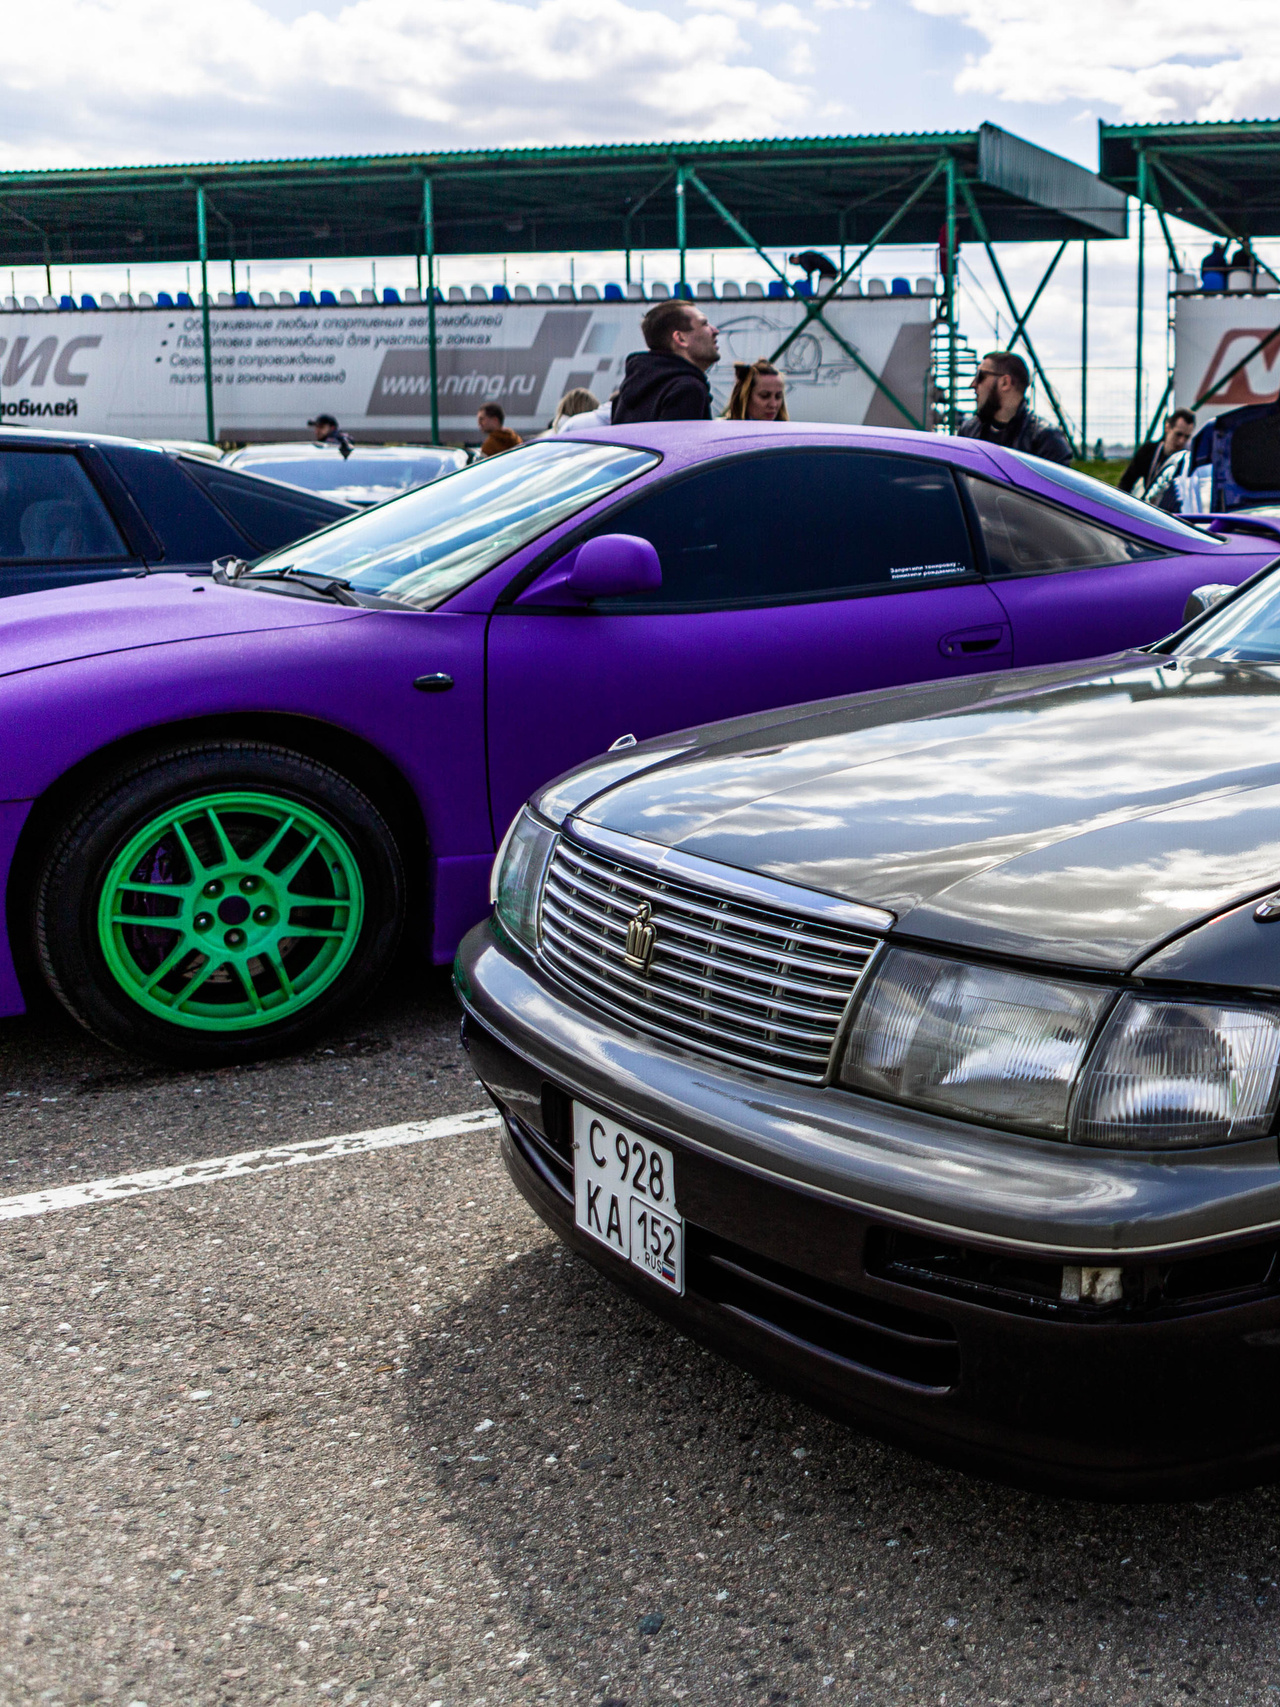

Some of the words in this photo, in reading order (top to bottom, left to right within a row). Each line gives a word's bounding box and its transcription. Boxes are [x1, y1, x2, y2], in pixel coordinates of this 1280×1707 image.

[183, 317, 273, 333] Облуживание
[176, 334, 252, 349] Подотовка
[615, 1132, 664, 1201] 928
[587, 1178, 623, 1247] КА
[637, 1211, 676, 1265] 152
[644, 1251, 662, 1274] RUS
